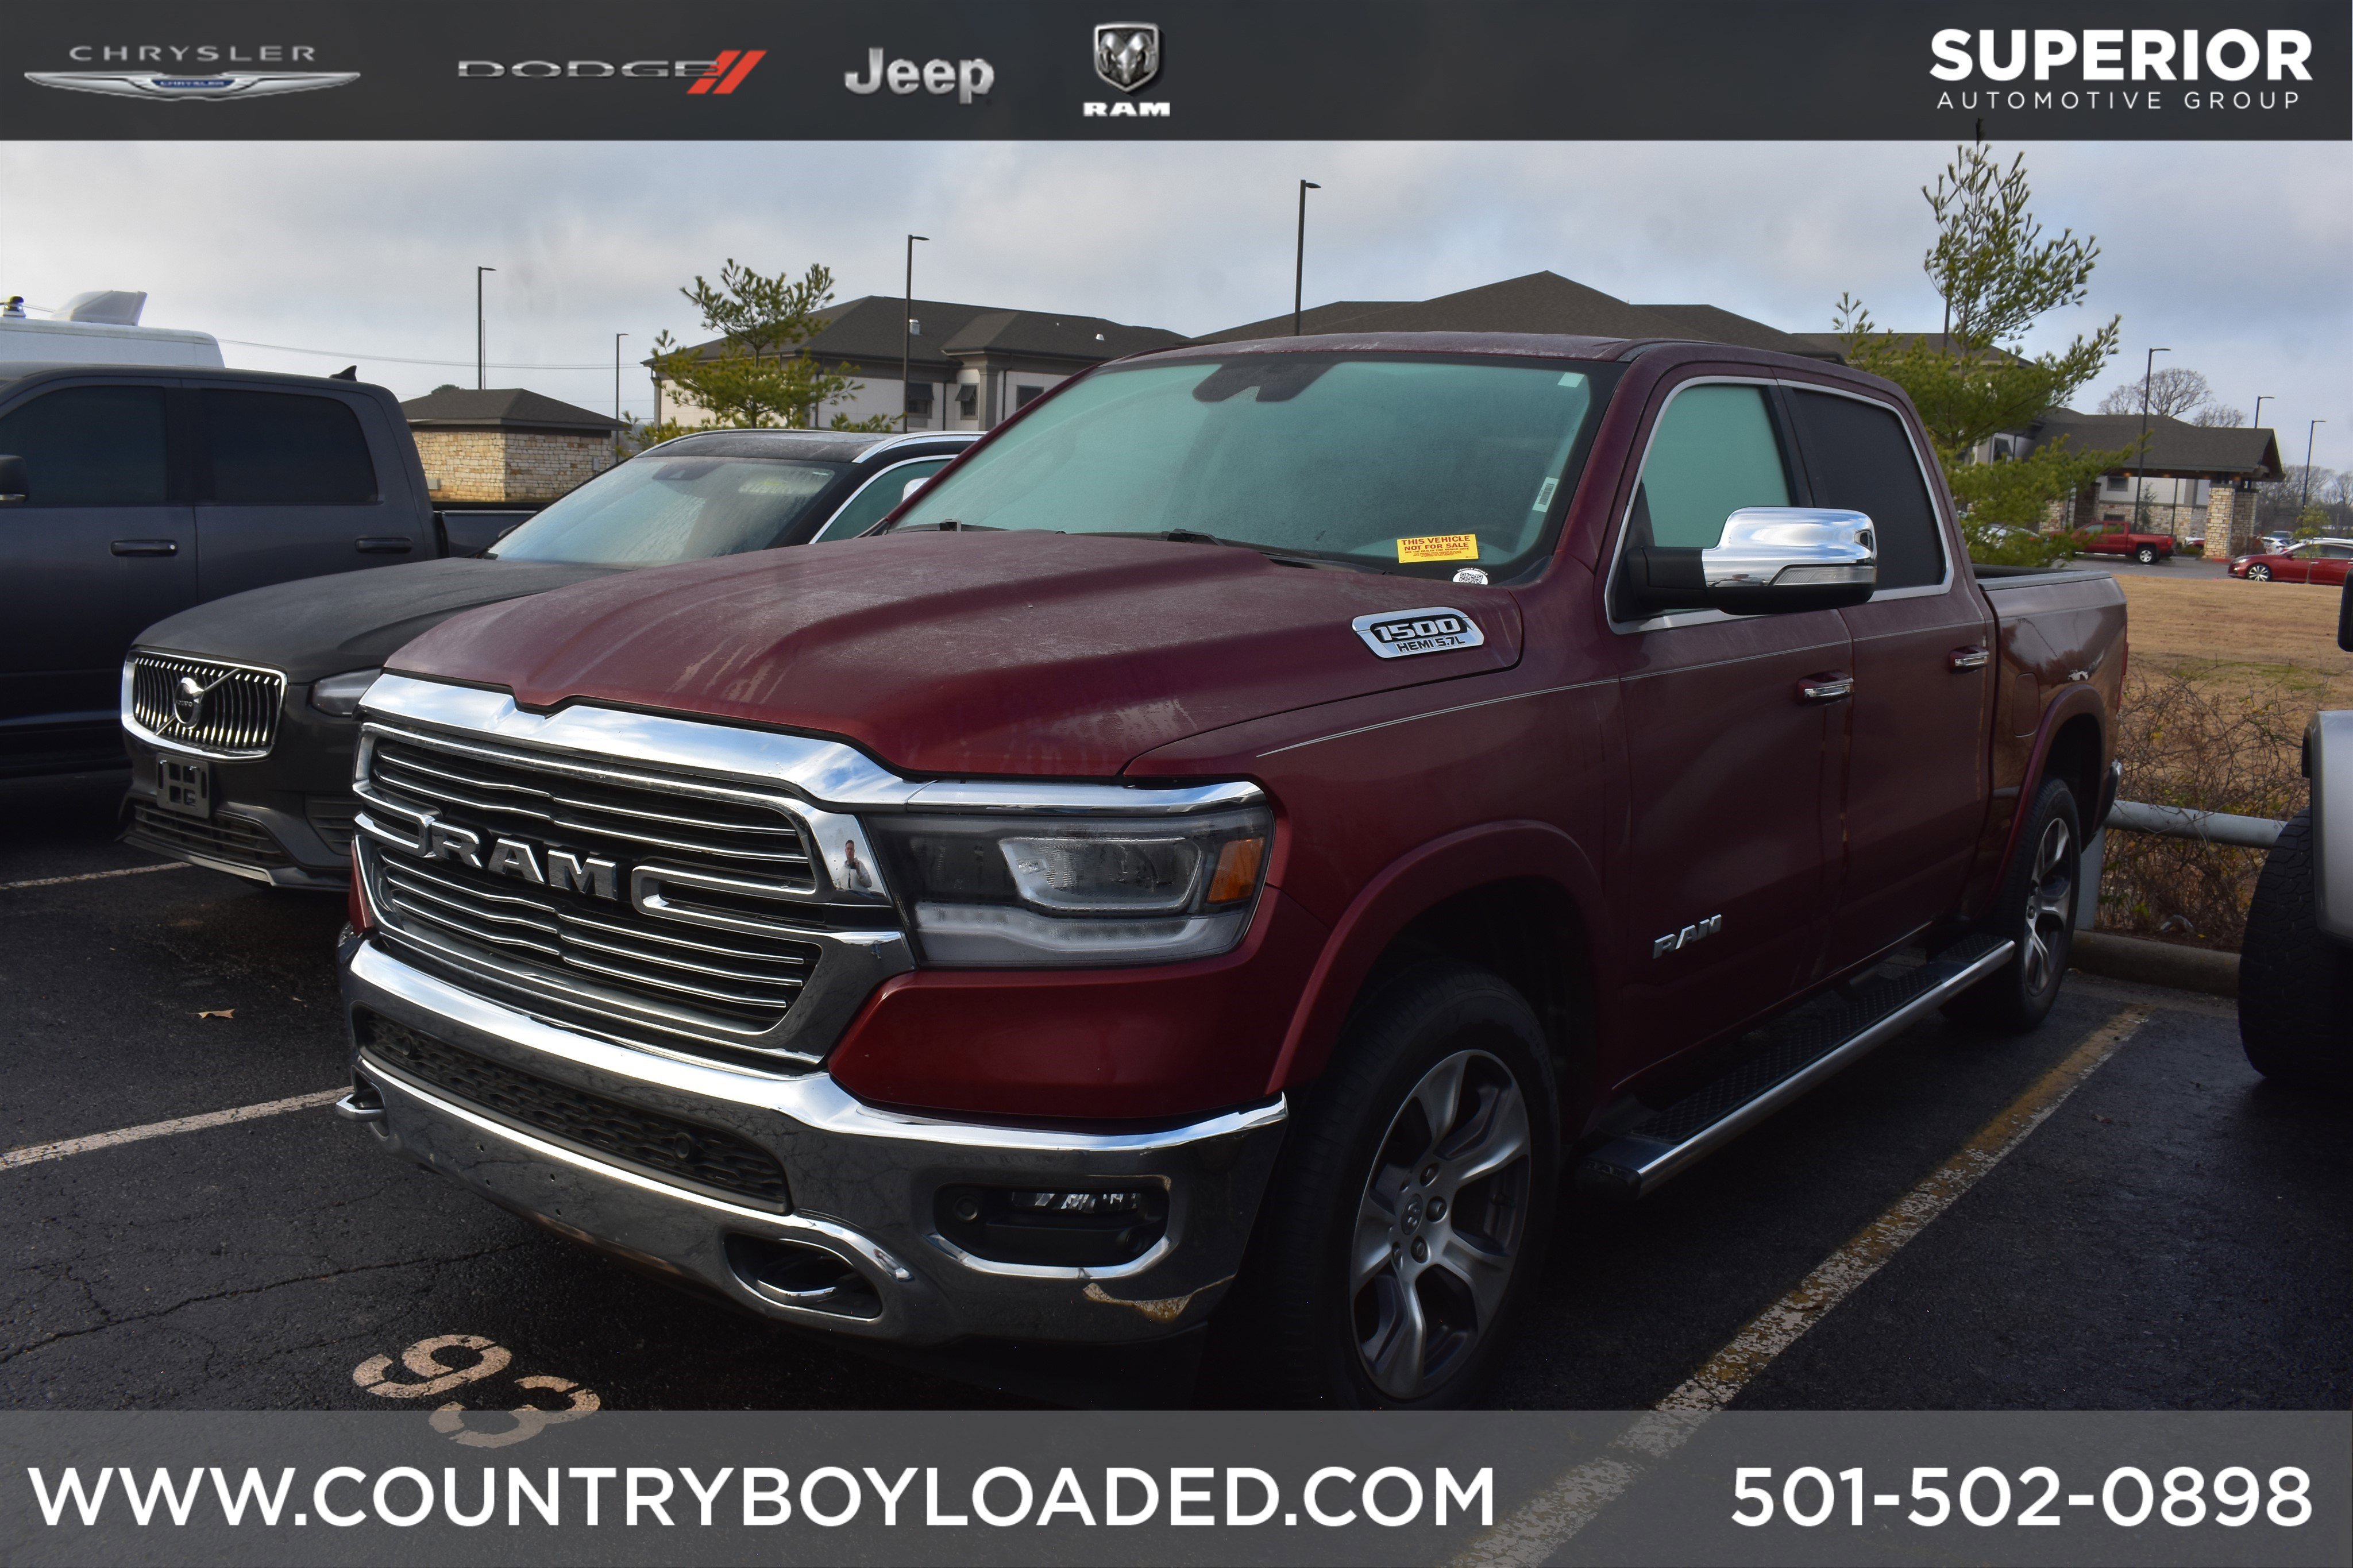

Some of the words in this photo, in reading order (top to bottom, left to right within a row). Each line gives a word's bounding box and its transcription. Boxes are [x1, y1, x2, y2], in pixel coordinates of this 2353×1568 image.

[1427, 535, 1471, 544] VEHICLE
[1374, 618, 1461, 641] 1500
[1396, 639, 1434, 652] HEMI
[1436, 636, 1465, 647] 5.7L
[431, 821, 618, 901] RAM
[1652, 914, 1722, 959] RAM
[353, 1334, 600, 1449] 93
